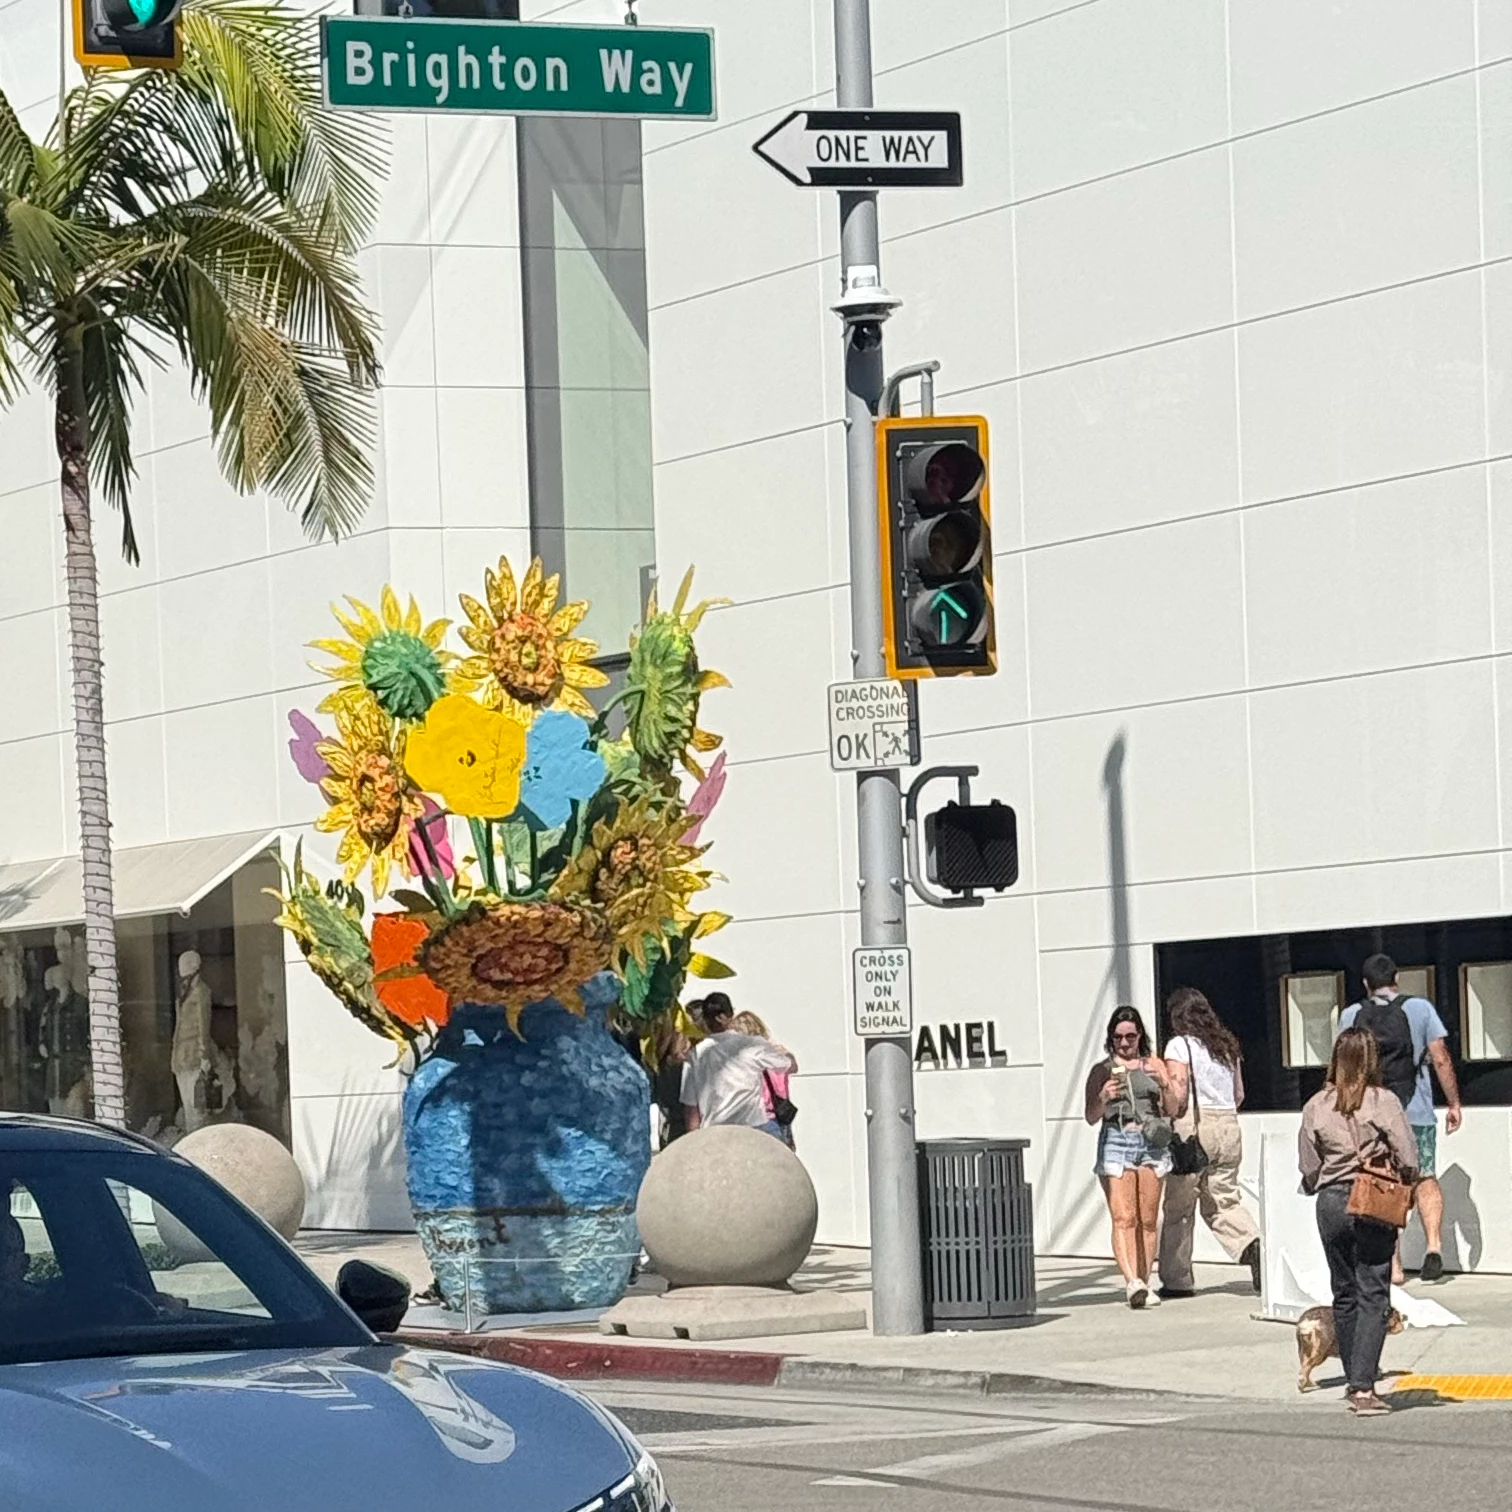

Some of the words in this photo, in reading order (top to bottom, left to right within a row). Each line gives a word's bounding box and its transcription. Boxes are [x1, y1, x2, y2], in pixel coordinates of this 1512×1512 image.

[345, 40, 568, 105] Brighton
[599, 48, 693, 108] Way
[816, 134, 869, 163] ONE
[881, 134, 935, 163] WAY
[837, 732, 871, 761] OK
[859, 953, 904, 968] CROSS
[865, 969, 899, 983] ONLY
[873, 984, 892, 998] ON
[865, 999, 901, 1013] WALK
[859, 1015, 907, 1029] SIGNAL
